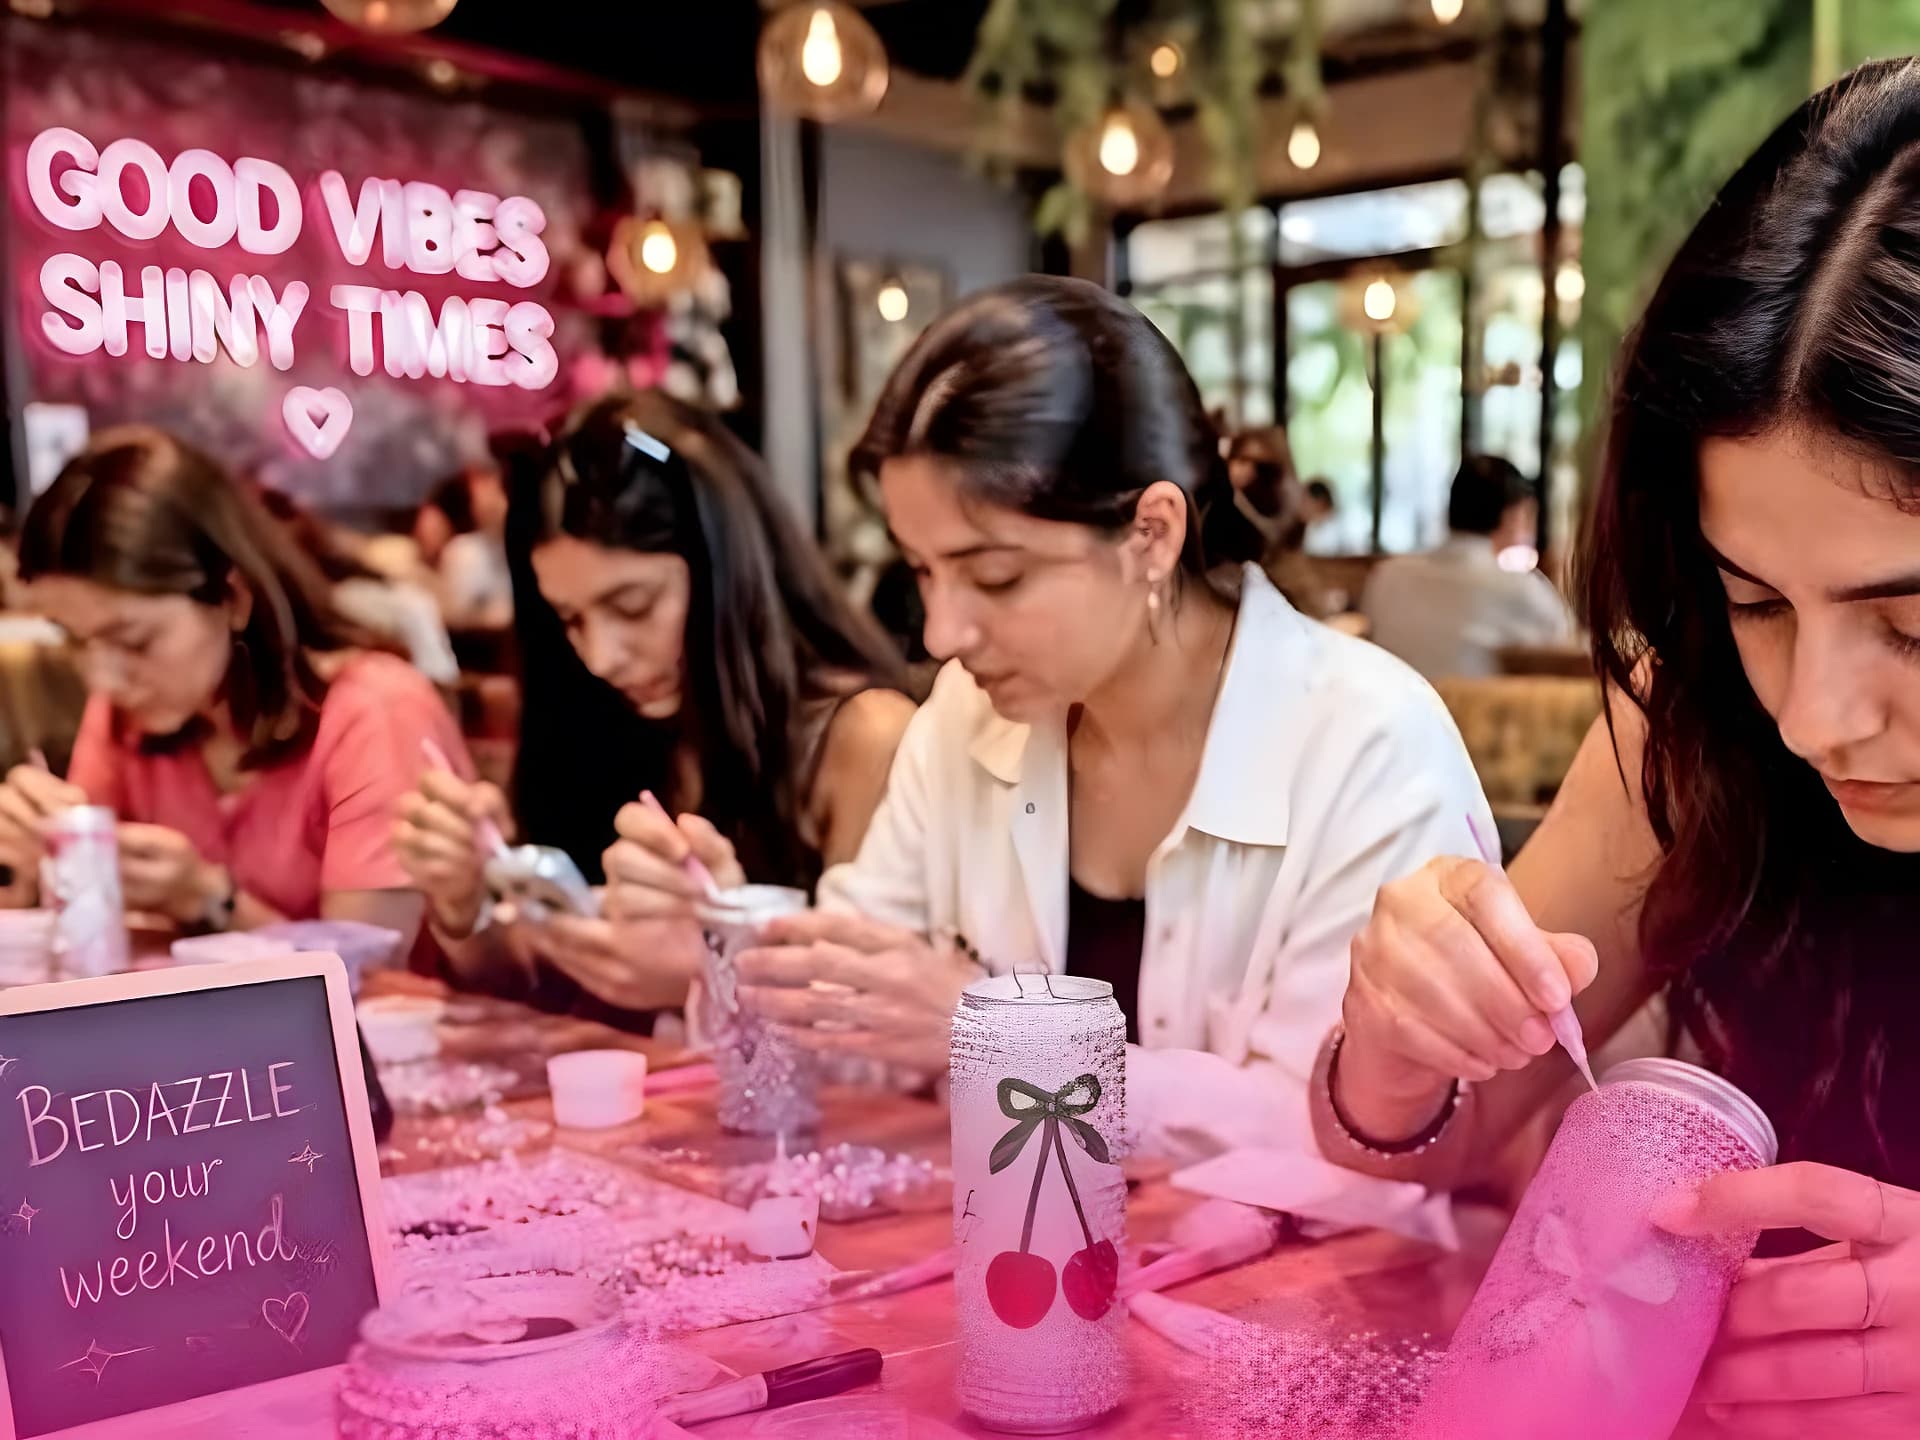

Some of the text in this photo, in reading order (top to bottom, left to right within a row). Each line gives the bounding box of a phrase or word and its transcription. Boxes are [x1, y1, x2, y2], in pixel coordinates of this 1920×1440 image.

[27, 127, 549, 288] GOOD VIBES
[40, 253, 558, 390] SHINY TIMES
[16, 1061, 300, 1167] BEDAZZLE
[60, 1194, 298, 1308] weekend
[110, 1159, 223, 1239] your
